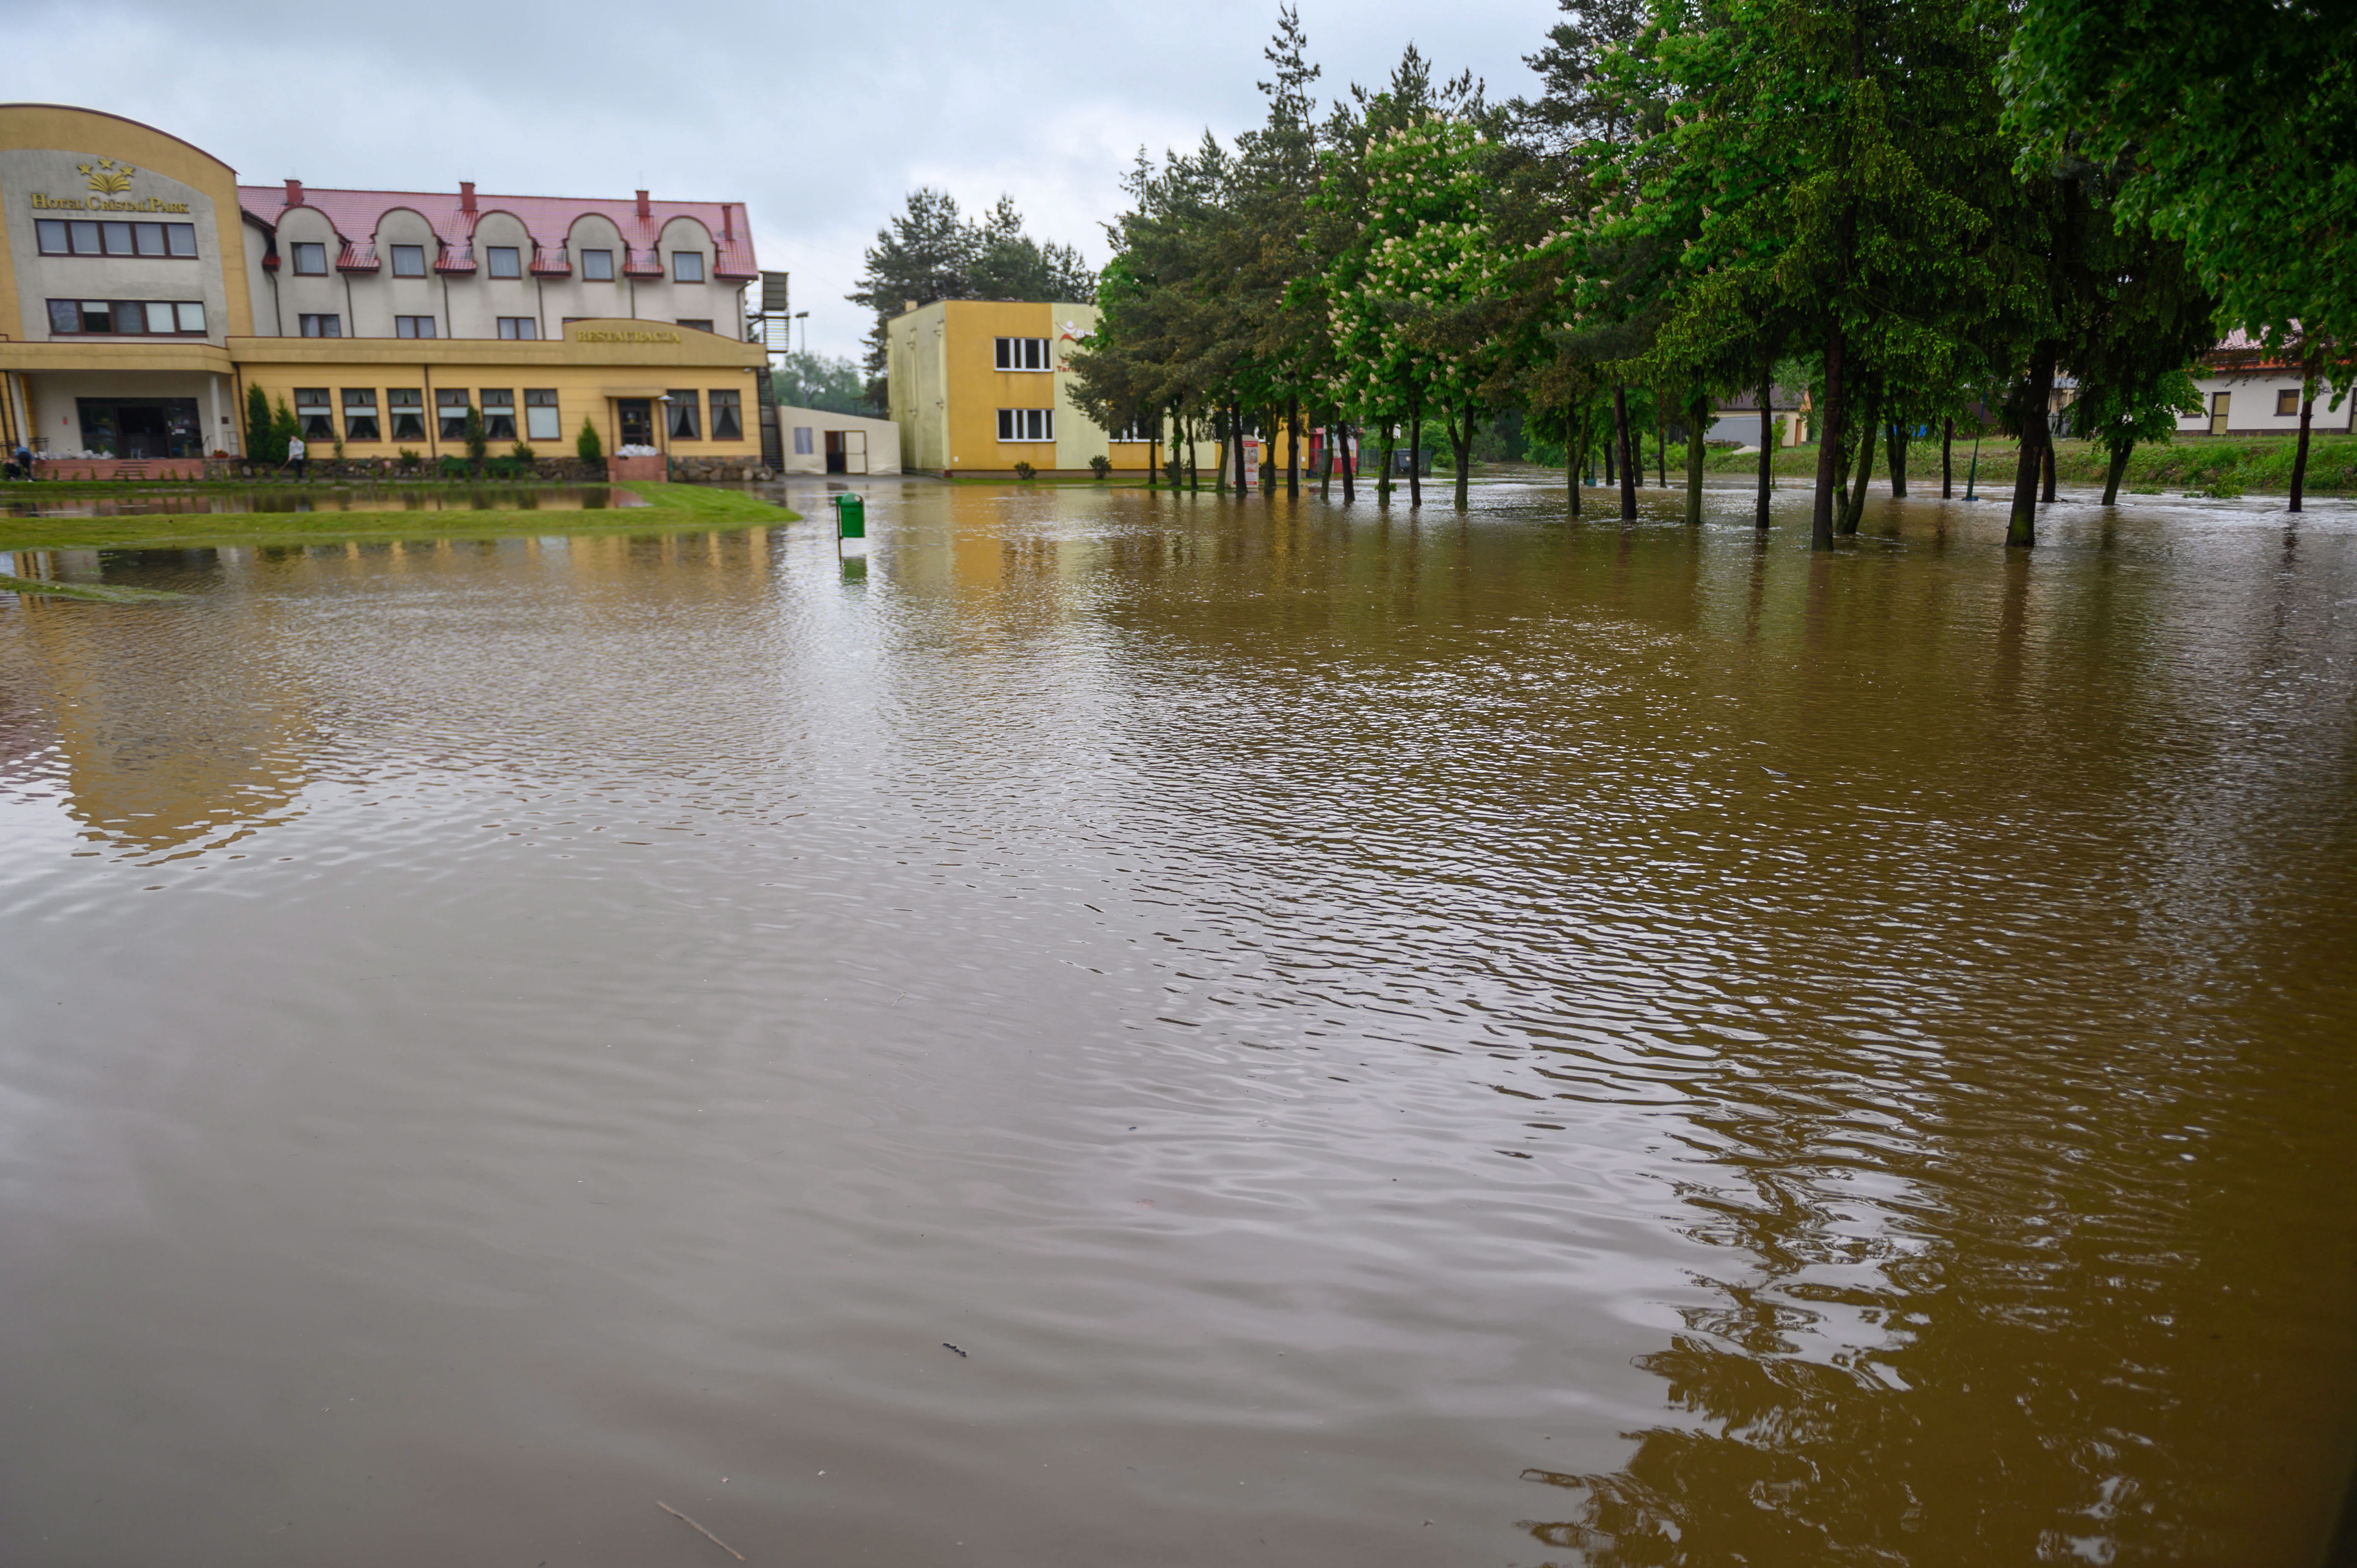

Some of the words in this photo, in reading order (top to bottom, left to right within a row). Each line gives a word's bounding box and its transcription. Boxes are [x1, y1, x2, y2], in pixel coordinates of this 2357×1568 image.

[31, 194, 84, 209] HOTEL
[86, 196, 146, 211] CRISTAL
[148, 197, 189, 213] PARK
[577, 331, 681, 343] RESTAURACJA
